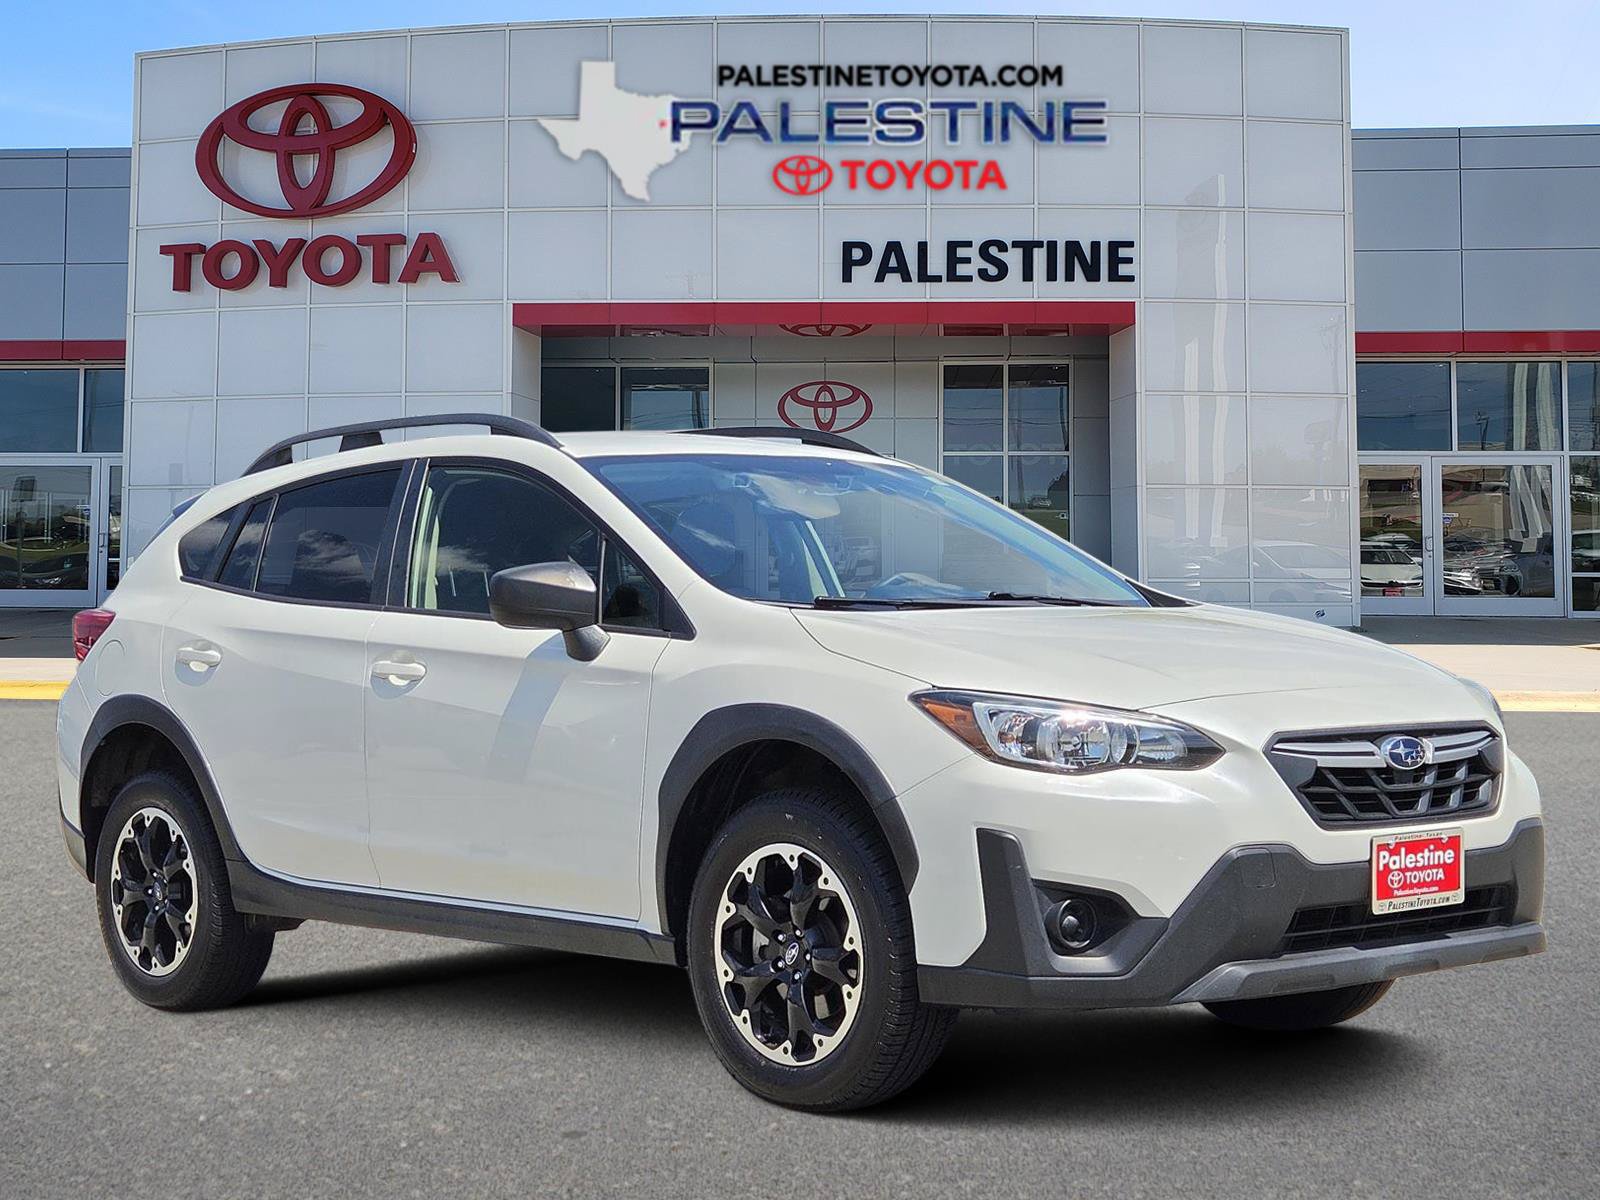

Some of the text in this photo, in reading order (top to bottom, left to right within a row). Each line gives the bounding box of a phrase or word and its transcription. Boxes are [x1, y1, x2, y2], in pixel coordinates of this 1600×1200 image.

[160, 232, 460, 293] TOYOTA
[842, 239, 1136, 284] PALESTINE
[1379, 845, 1454, 871] Palestine
[1405, 868, 1444, 884] TOYOTA
